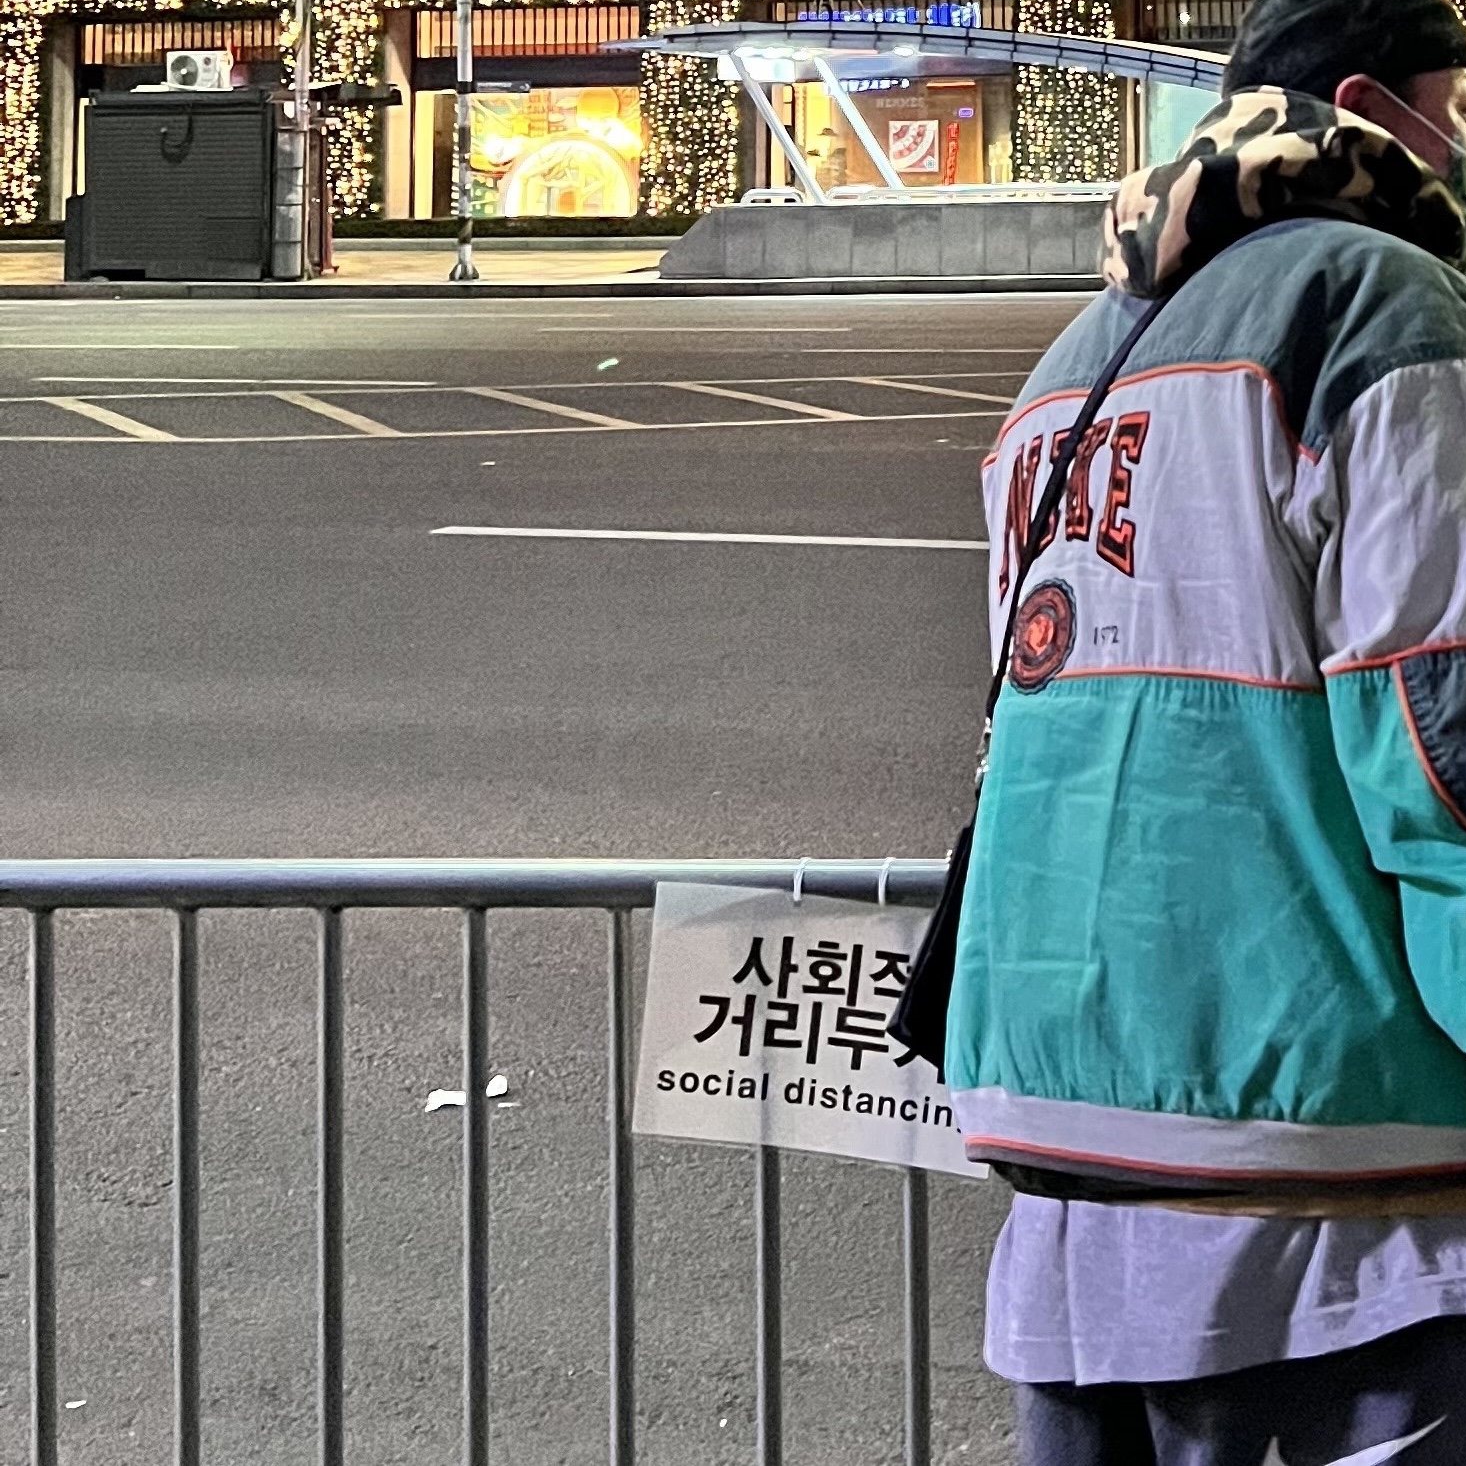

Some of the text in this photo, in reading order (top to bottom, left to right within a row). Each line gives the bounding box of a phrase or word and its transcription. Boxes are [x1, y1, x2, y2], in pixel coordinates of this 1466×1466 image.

[693, 993, 921, 1071] 거리두
[657, 1069, 962, 1134] social distancin
